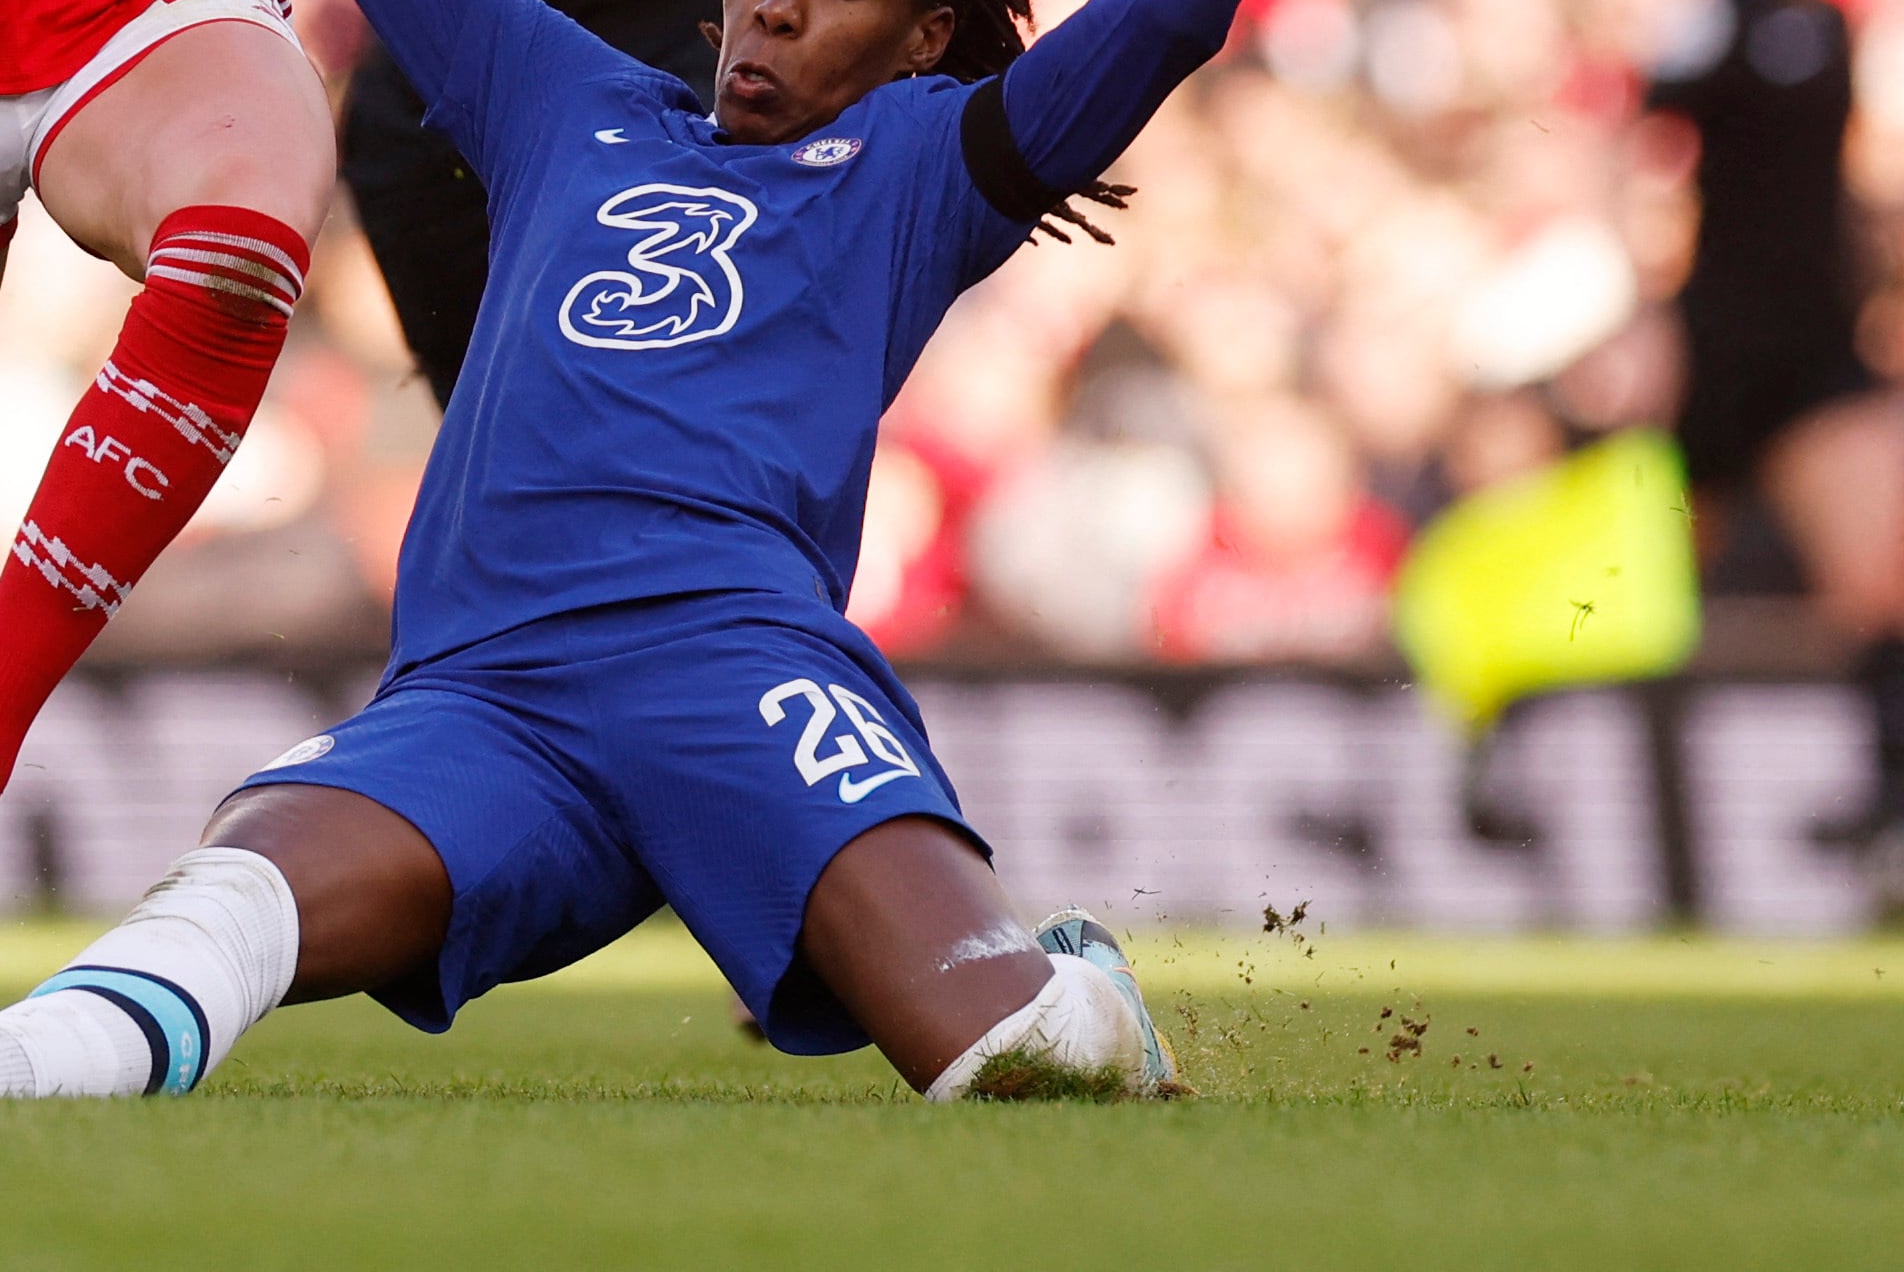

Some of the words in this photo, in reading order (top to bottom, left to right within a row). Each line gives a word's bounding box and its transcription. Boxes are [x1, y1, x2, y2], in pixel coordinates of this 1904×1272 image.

[558, 182, 759, 351] 3
[64, 424, 173, 502] AFC
[758, 678, 922, 787] 26
